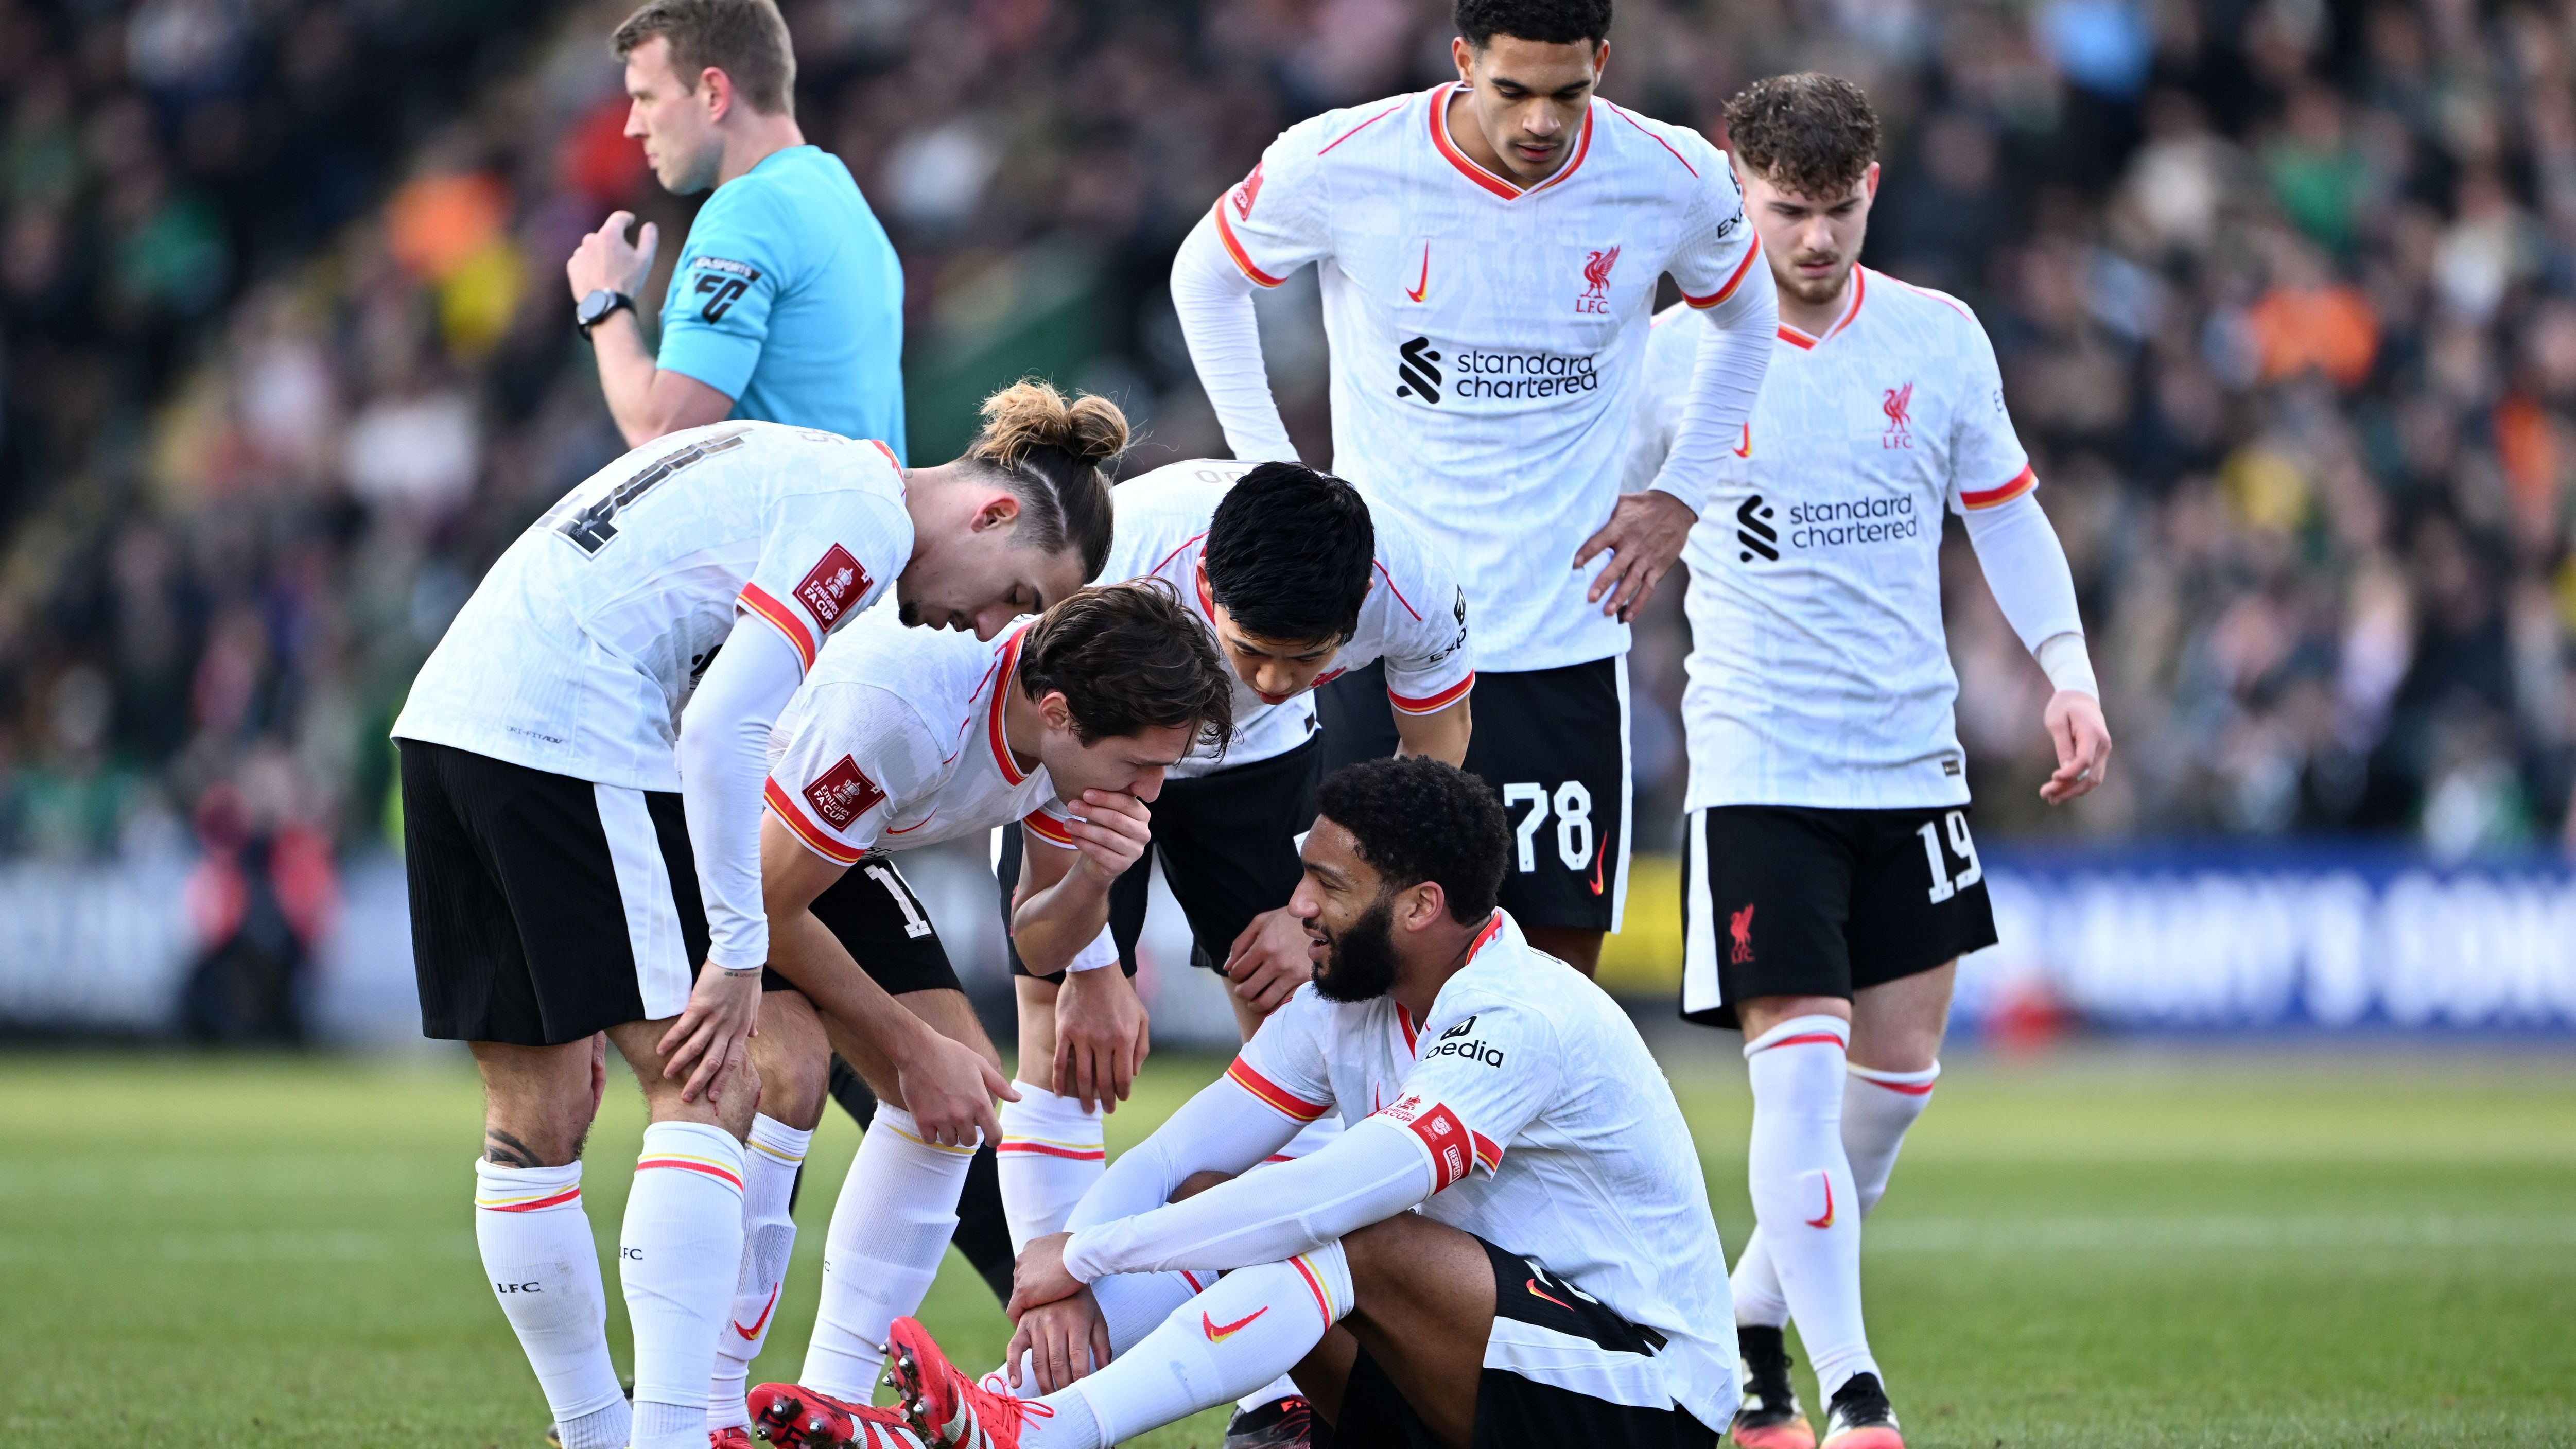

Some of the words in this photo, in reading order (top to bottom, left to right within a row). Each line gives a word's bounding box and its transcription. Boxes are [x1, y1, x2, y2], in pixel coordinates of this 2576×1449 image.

[1457, 350, 1596, 376] standard
[1456, 370, 1598, 399] chartered
[1790, 493, 1912, 525] standard
[1792, 515, 1917, 549] chartered
[804, 587, 817, 604] FA
[816, 600, 834, 621] CUP
[810, 580, 840, 615] Emirates
[814, 790, 825, 806] FA
[823, 805, 846, 821] CUP
[821, 784, 850, 817] Emirates
[1503, 780, 1593, 873] 78
[1916, 810, 1982, 905] 19
[1424, 1039, 1504, 1069] pedia
[1383, 1107, 1416, 1120] Emirates
[1389, 1112, 1412, 1122] CUP
[1448, 1148, 1461, 1178] RESPECT
